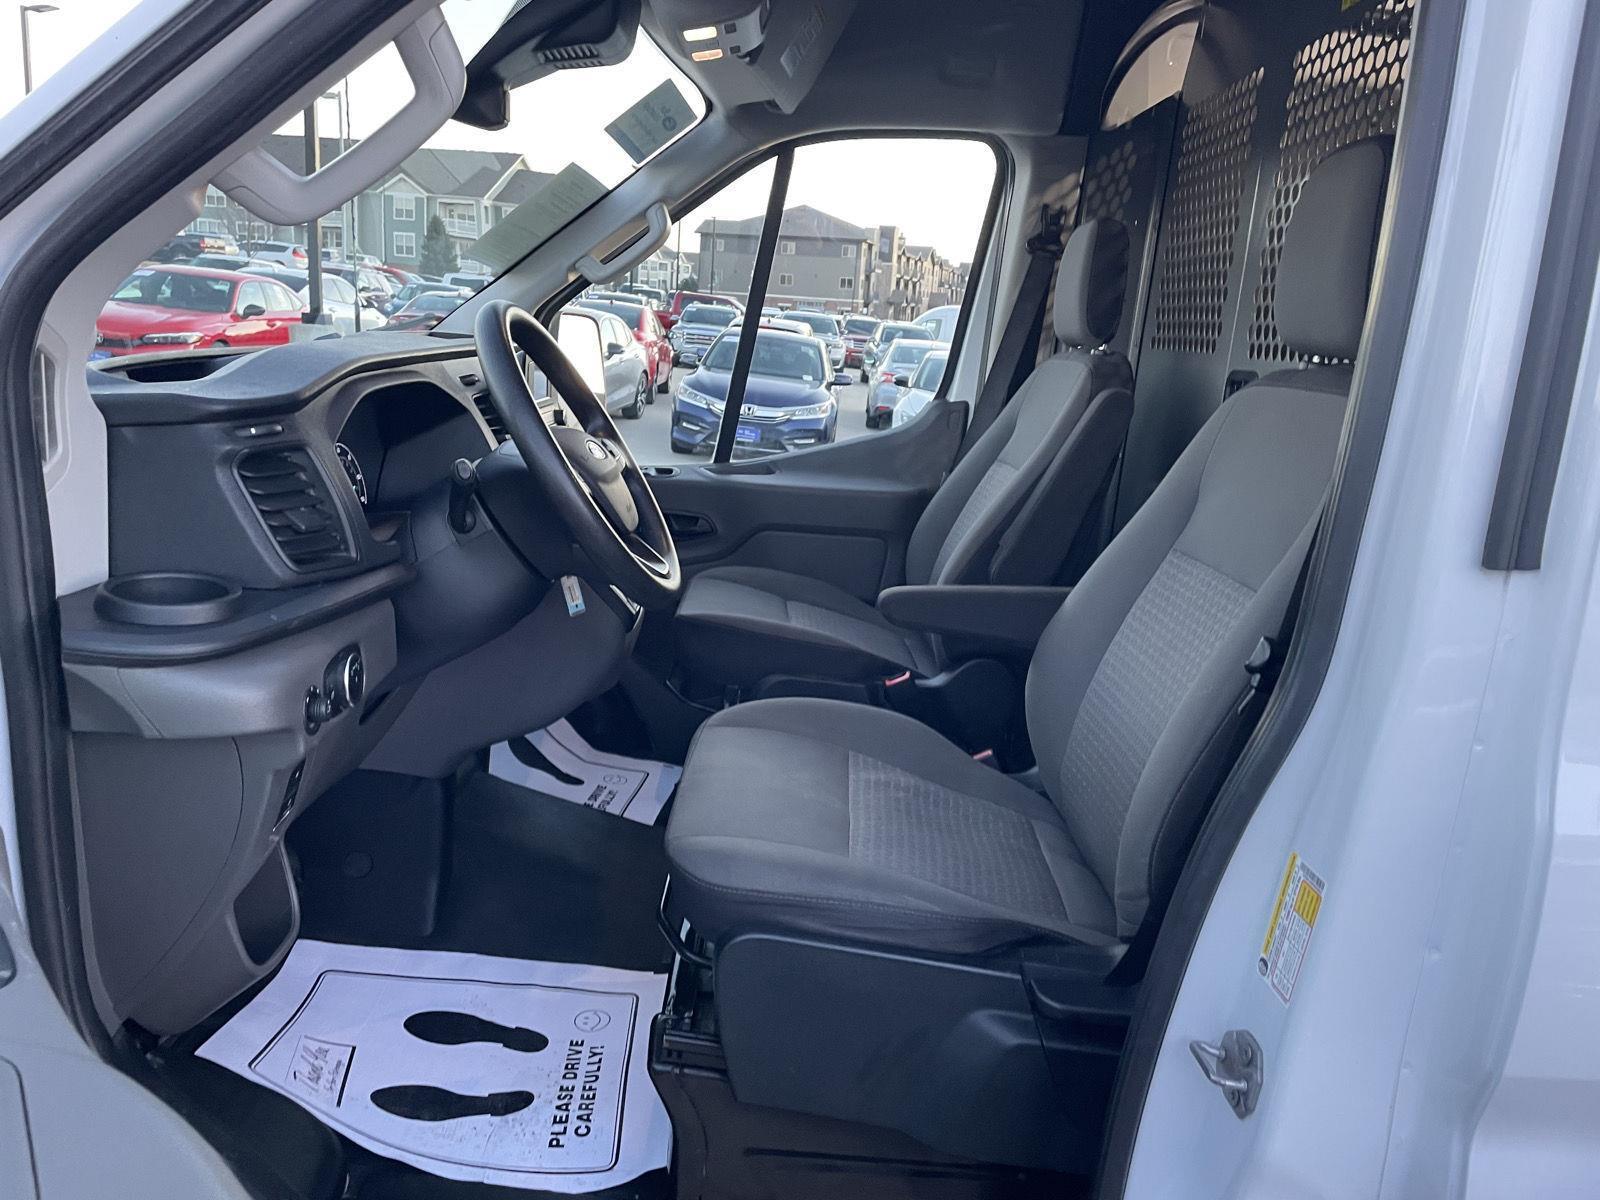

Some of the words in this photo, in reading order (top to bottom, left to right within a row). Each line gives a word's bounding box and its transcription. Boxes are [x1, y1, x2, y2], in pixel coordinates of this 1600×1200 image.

[548, 1085, 575, 1148] PLEASE
[562, 1040, 584, 1080] DRIVE
[574, 1045, 604, 1137] CAREFULLY!
